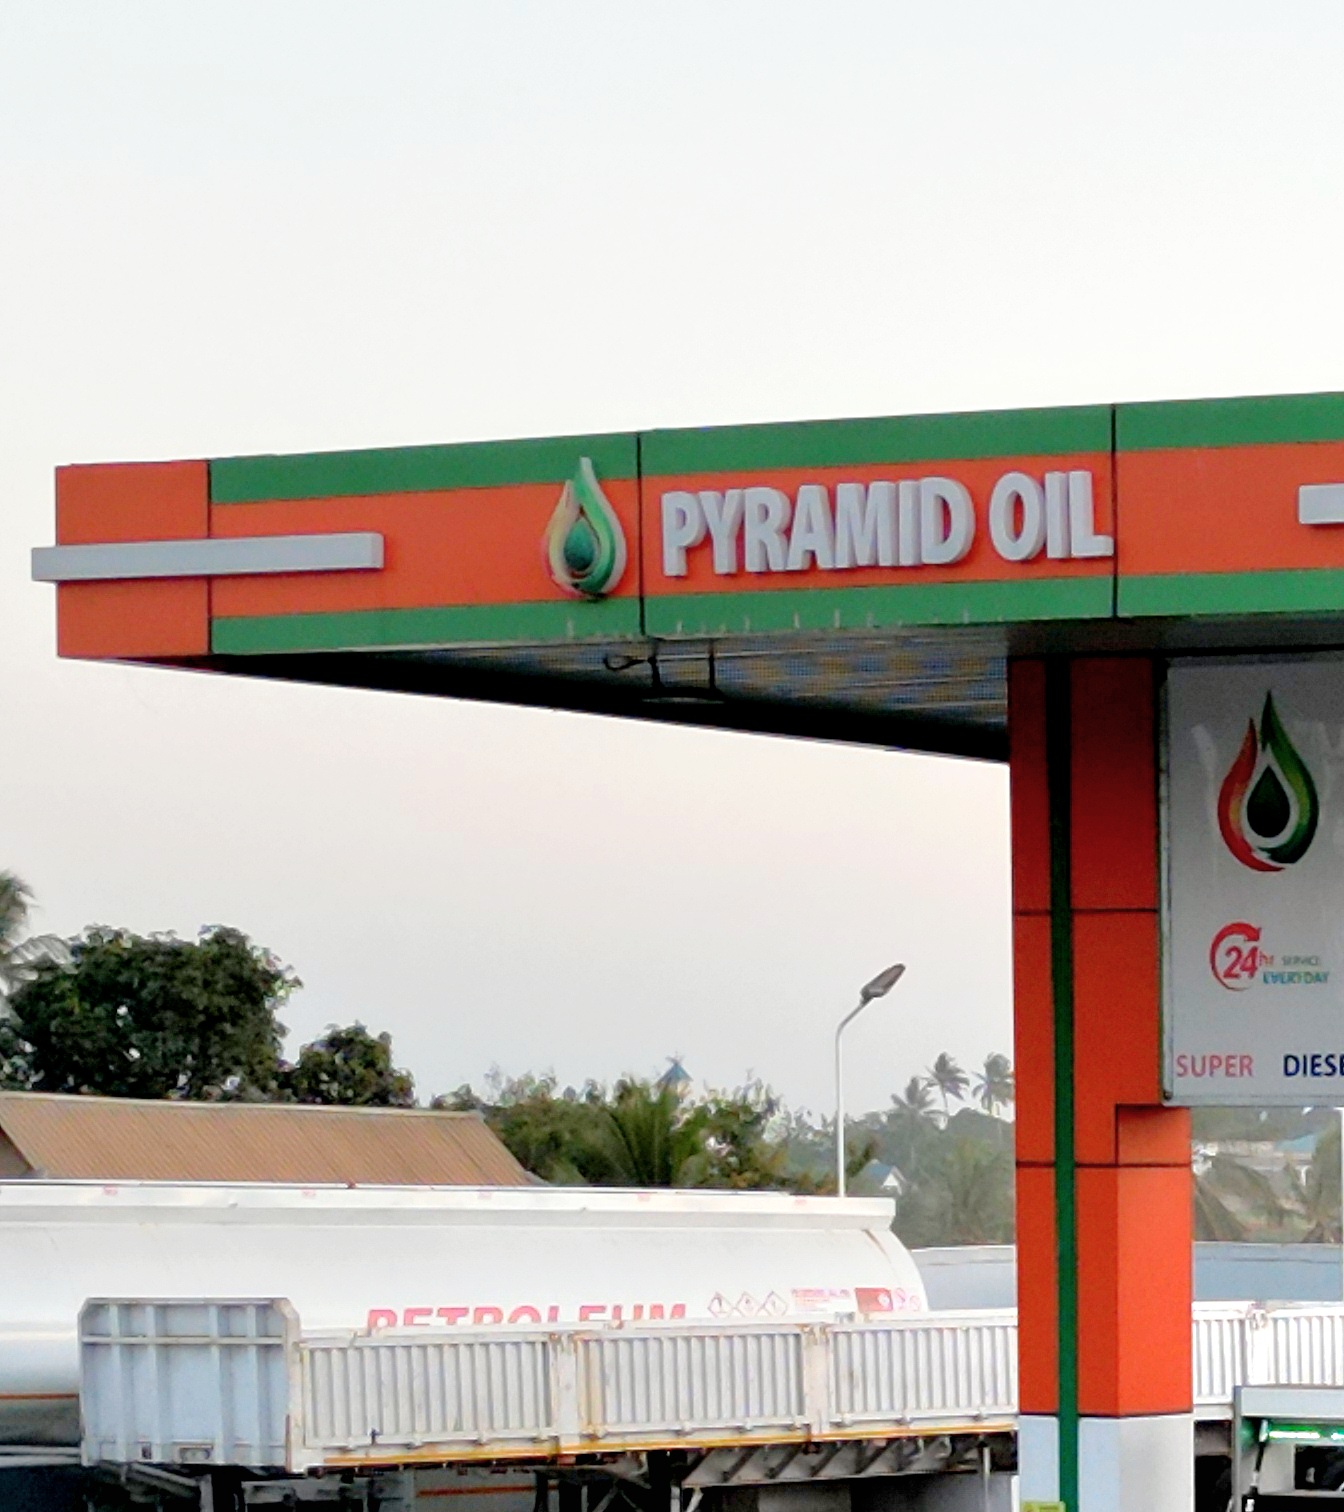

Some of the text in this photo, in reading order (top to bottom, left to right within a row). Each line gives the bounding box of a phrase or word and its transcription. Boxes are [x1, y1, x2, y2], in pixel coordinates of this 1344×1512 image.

[661, 470, 1115, 576] PYRAMID OIL
[1175, 1053, 1254, 1079] SUPER
